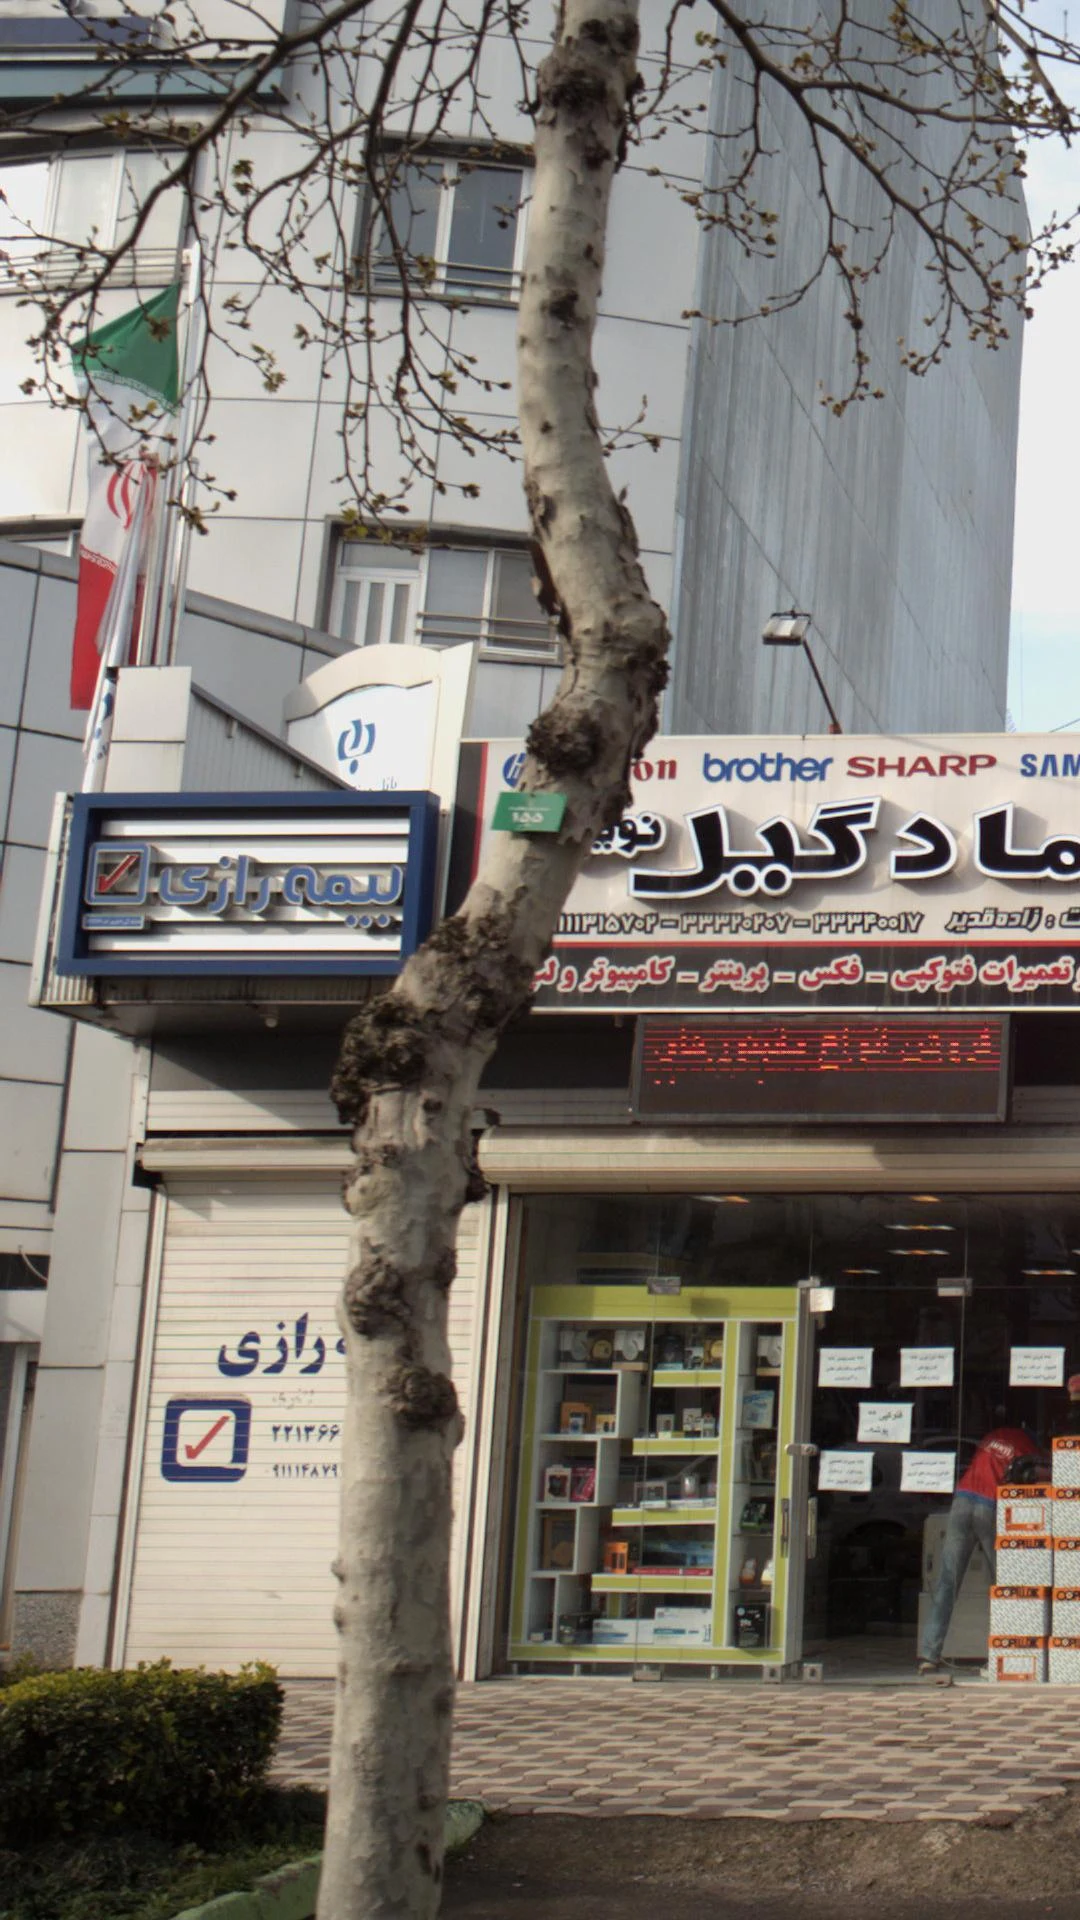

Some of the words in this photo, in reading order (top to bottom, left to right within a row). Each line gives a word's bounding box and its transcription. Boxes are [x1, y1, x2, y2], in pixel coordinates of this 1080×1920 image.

[703, 751, 834, 783] brother
[847, 754, 997, 777] SHARP
[591, 811, 667, 859] نوی
[628, 797, 882, 899] گیل
[157, 854, 271, 914] رازی
[282, 864, 404, 929] بیمه
[557, 912, 659, 935] ۱۱۱۳۱۵۷۰۲
[557, 966, 578, 993] و
[579, 956, 675, 993] کامپیوتر
[698, 959, 769, 992] پرینتر
[798, 954, 863, 990] فکس
[891, 955, 976, 991] فتوکپی
[980, 956, 1074, 991] تعمیرات
[217, 1312, 326, 1378] رازی
[272, 1424, 340, 1442] ۲۲۱۳۶۶
[272, 1464, 338, 1478] ۹۱۱۱۴۸۷۹
